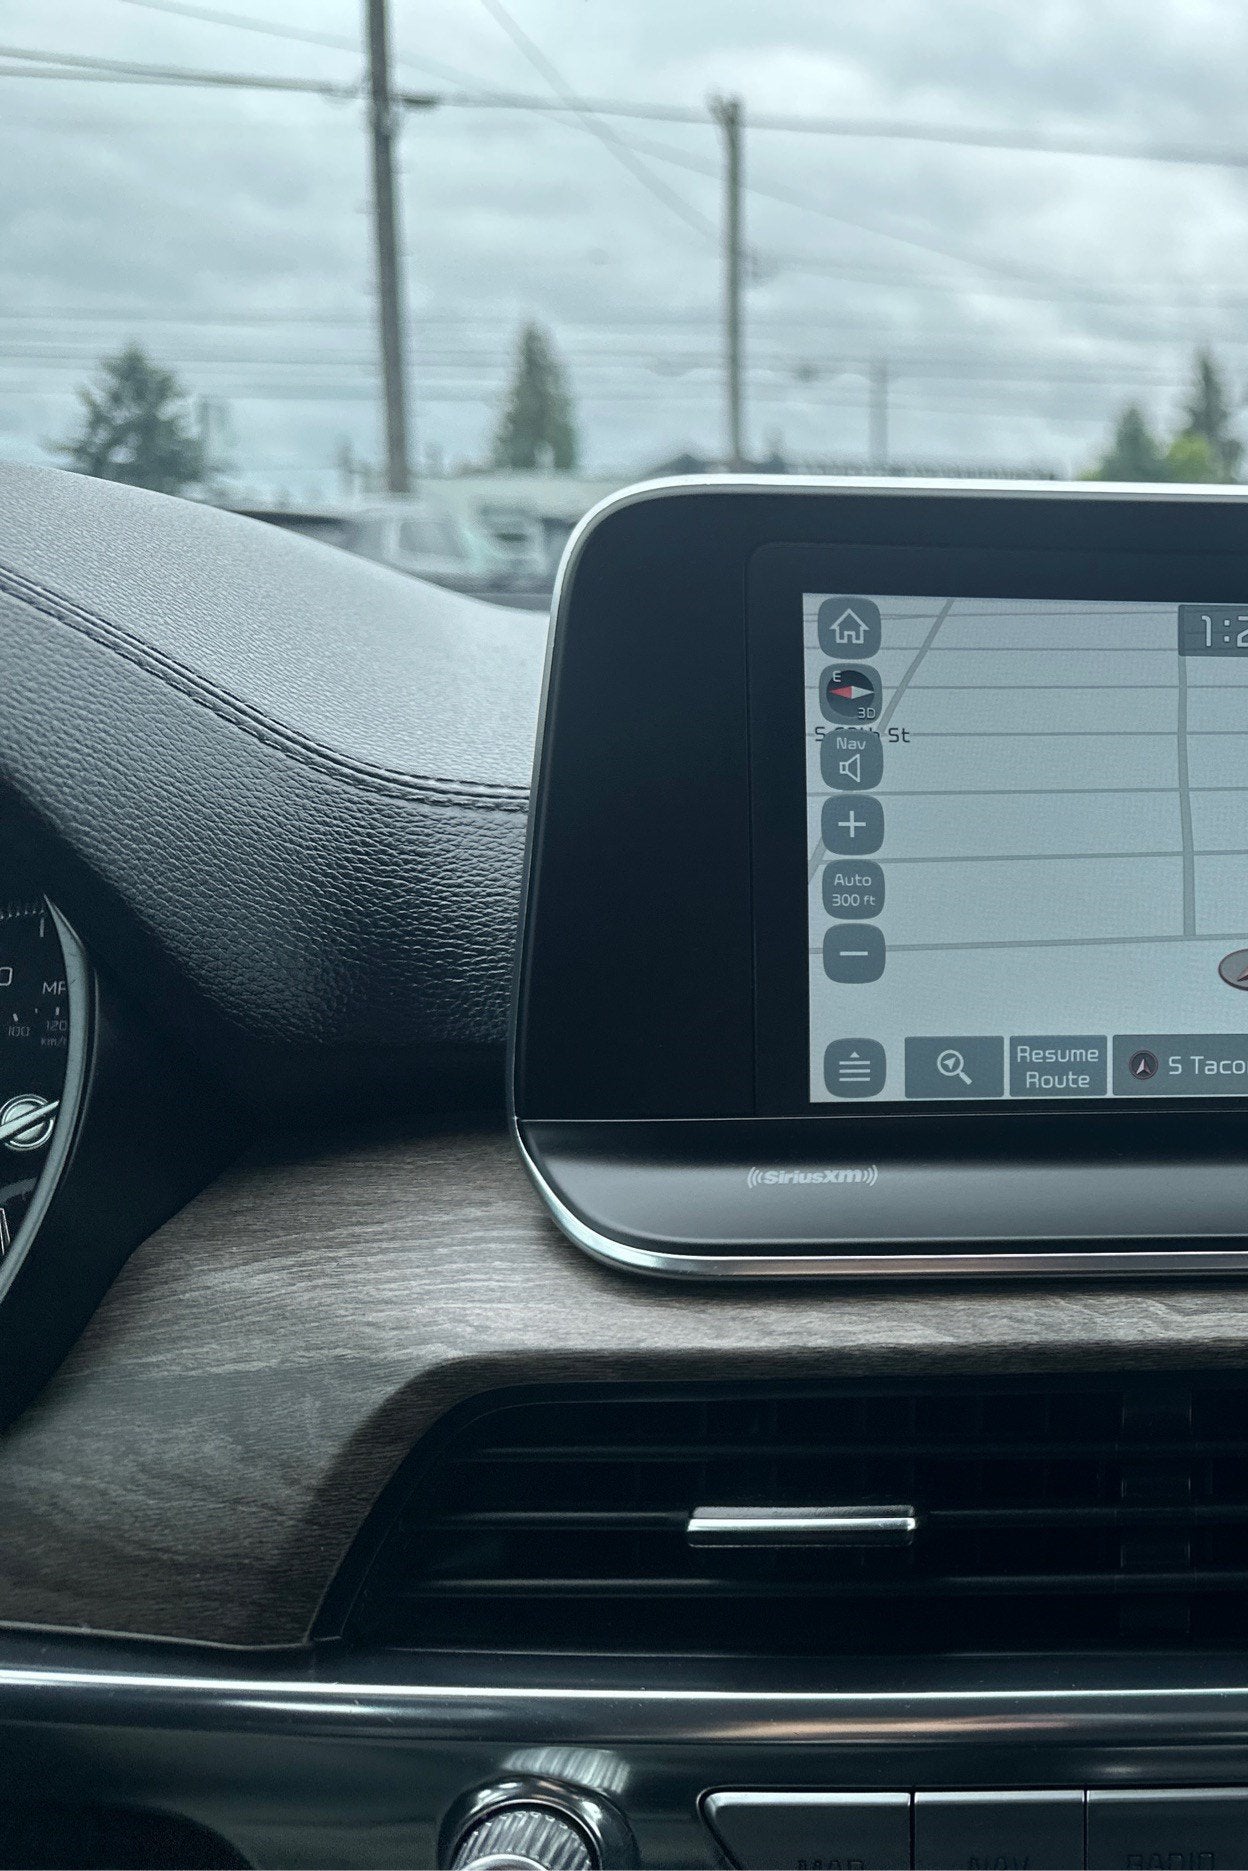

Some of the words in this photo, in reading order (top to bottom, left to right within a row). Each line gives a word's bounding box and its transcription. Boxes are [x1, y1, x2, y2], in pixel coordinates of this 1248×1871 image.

[833, 671, 842, 682] E
[858, 707, 876, 719] 3D
[814, 726, 826, 742] S
[888, 727, 911, 743] St
[836, 737, 866, 750] Nav
[834, 872, 872, 887] Auto
[832, 893, 861, 907] 300
[864, 893, 876, 906] ft
[1017, 1046, 1099, 1063] Resume
[1169, 1056, 1182, 1075] S
[1026, 1071, 1090, 1089] Route
